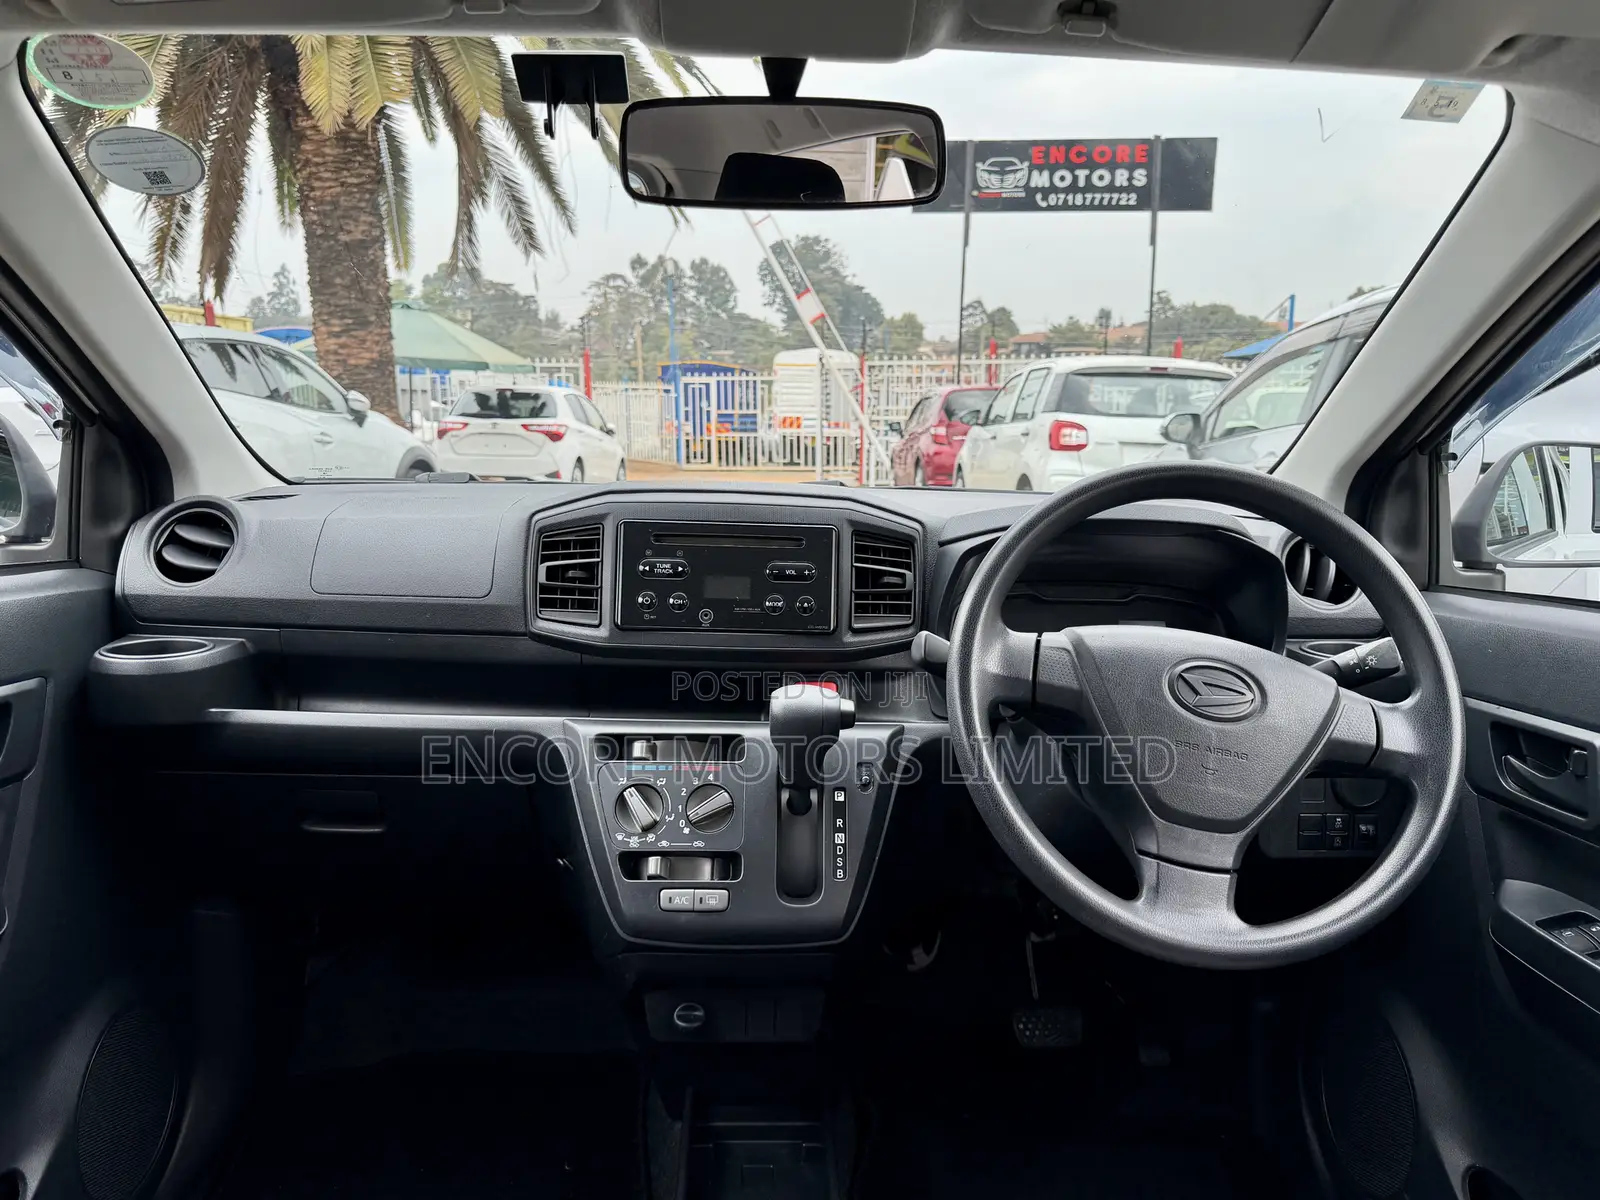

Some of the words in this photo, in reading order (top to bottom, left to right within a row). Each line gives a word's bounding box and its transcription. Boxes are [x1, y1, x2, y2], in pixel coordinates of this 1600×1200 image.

[62, 71, 73, 81] 8
[1031, 144, 1149, 164] ENCORE
[1029, 168, 1148, 188] MOTORS
[1205, 746, 1249, 761] AIRBAG
[692, 777, 699, 785] 3
[707, 773, 714, 781] 4
[680, 788, 687, 796] 2
[677, 805, 682, 813] 1
[679, 820, 686, 828] 0
[836, 819, 843, 828] R
[836, 834, 843, 842] N
[836, 846, 844, 855] D
[836, 858, 843, 867] S
[836, 869, 844, 879] B
[674, 894, 689, 905] A/C
